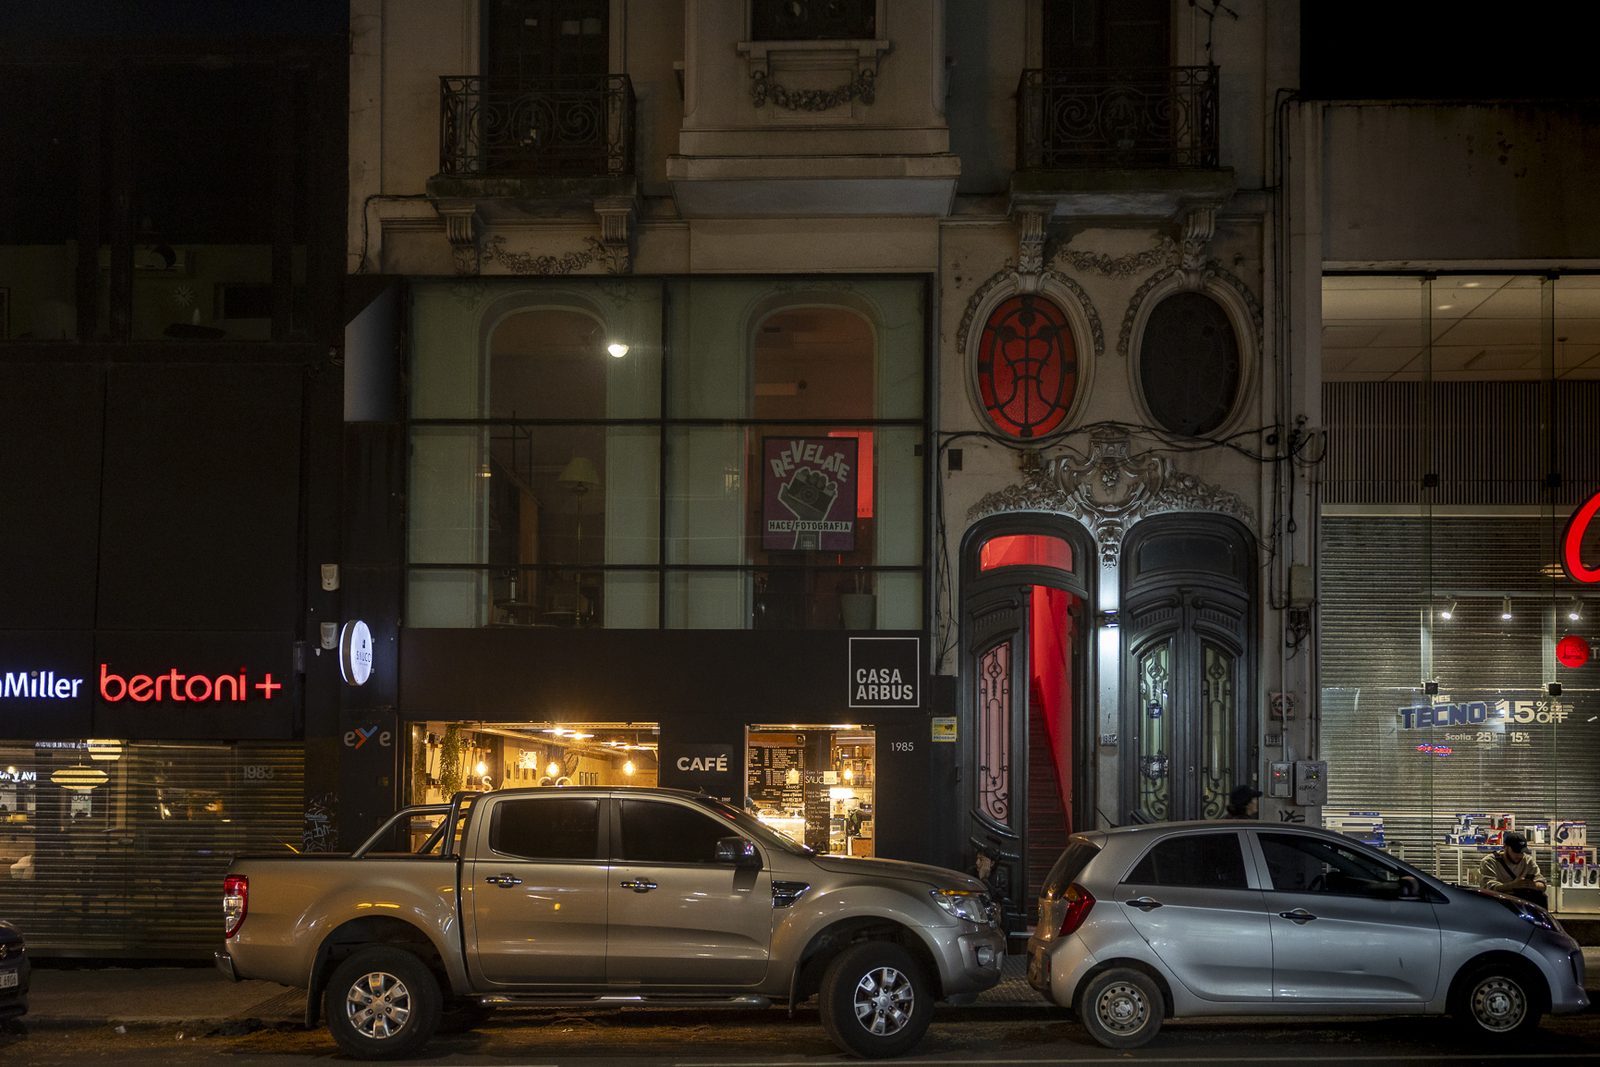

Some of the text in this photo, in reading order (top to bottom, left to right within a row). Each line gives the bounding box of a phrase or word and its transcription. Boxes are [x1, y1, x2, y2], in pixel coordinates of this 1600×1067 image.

[770, 440, 850, 483] REVELATE
[769, 521, 791, 531] HACE
[100, 663, 247, 702] bertoni
[856, 668, 902, 684] CASA
[0, 671, 83, 699] Miller
[856, 684, 914, 700] ARBUS
[1398, 701, 1488, 731] TECNO
[1536, 712, 1569, 723] OFF
[890, 741, 914, 752] 1985
[676, 753, 728, 772] CAFÉ
